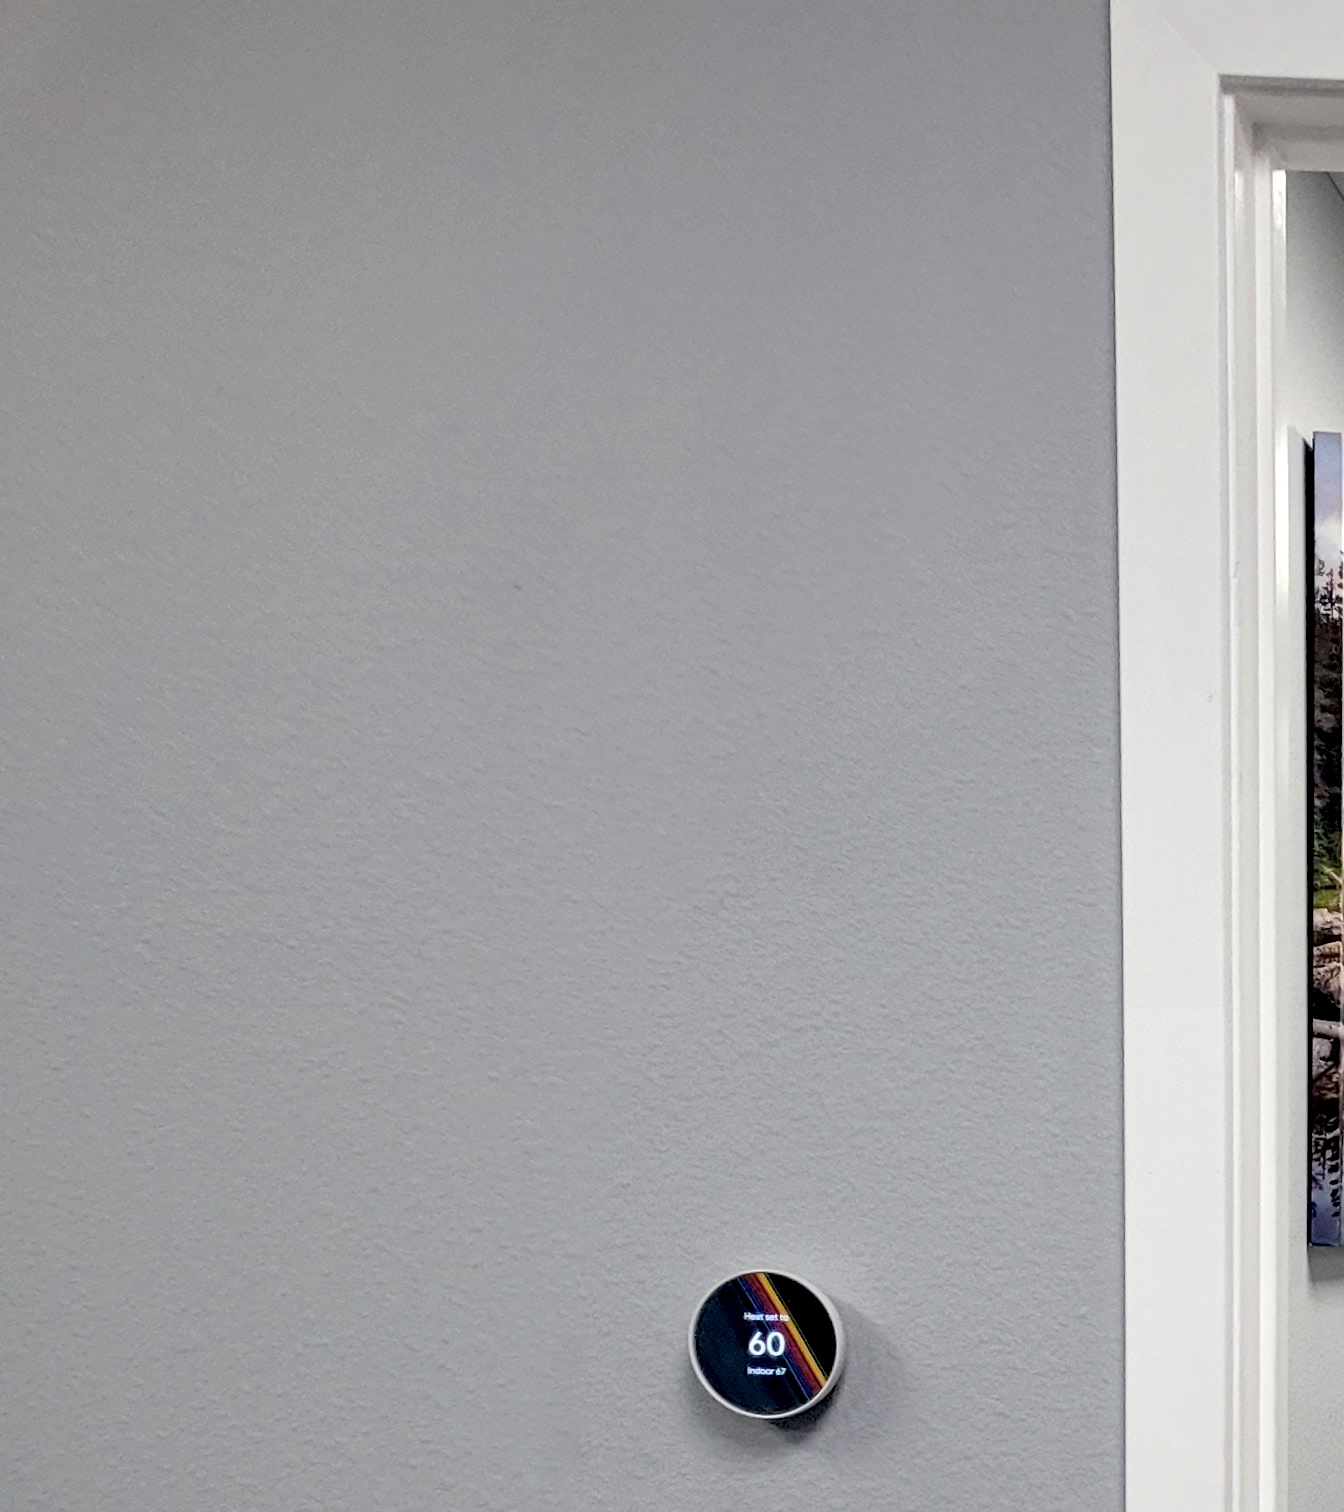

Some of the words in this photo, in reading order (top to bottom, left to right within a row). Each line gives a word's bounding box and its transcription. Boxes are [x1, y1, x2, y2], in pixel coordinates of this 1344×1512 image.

[743, 1312, 764, 1321] Heat
[765, 1313, 779, 1321] set
[780, 1313, 789, 1322] to
[748, 1331, 786, 1356] 60
[747, 1366, 774, 1375] Indoor
[775, 1367, 787, 1376] 67
